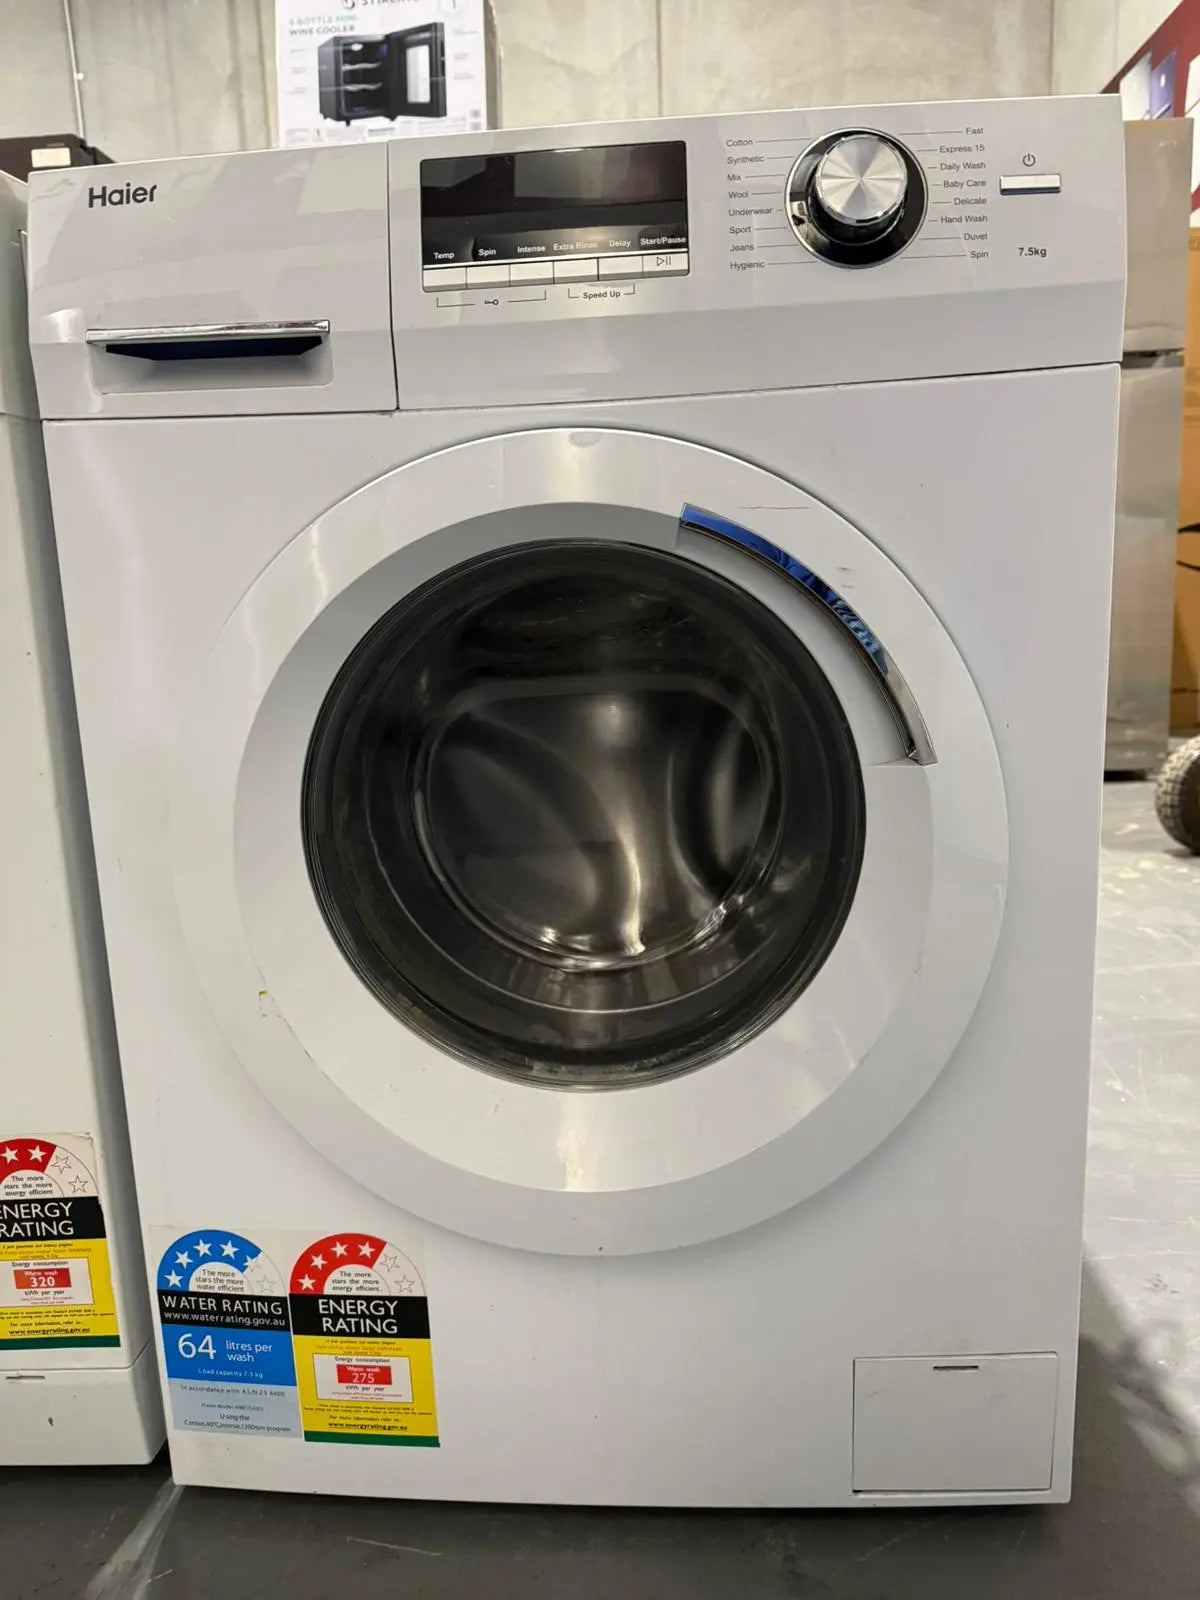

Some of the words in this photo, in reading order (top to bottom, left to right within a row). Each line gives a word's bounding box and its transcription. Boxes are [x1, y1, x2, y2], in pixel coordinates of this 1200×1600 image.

[289, 28, 314, 36] WINE
[316, 25, 355, 35] COOLER
[965, 127, 984, 135] Fast
[726, 139, 753, 147] Cotton
[939, 144, 972, 154] Express
[975, 144, 985, 152] 15
[727, 155, 765, 165] Synthetic
[940, 162, 960, 171] Daily
[962, 161, 986, 169] Wash
[727, 174, 741, 182] Mix
[943, 180, 964, 190] Baby
[966, 178, 987, 187] Care
[88, 182, 158, 208] Haier
[728, 191, 750, 199] Wool
[953, 196, 987, 205] Delicate
[728, 207, 773, 217] Underwear
[940, 214, 963, 223] Hand
[964, 213, 988, 222] Wash
[728, 225, 752, 236] Sport
[640, 236, 686, 246] Start/Pause
[963, 232, 988, 240] Duvet
[553, 243, 575, 251] Extra
[576, 241, 598, 249] Rinse
[609, 239, 632, 248] Delay
[730, 243, 755, 252] Jeans
[478, 248, 497, 257] Spin
[517, 245, 546, 254] Intense
[1018, 246, 1047, 258] 7.5kg
[433, 251, 455, 260] Temp
[970, 250, 989, 260] Spin
[730, 260, 766, 271] Hygienic
[583, 290, 608, 300] Speed
[609, 289, 621, 298] Up
[0, 1201, 72, 1220] NERGY
[202, 1269, 216, 1277] The
[30, 1276, 56, 1288] 320
[213, 1277, 225, 1285] the
[218, 1285, 245, 1293] efficient
[163, 1295, 217, 1312] WATER
[222, 1299, 283, 1315] RATING
[318, 1299, 398, 1315] ENERGY
[164, 1311, 286, 1327] www.waterrating.gov.au
[322, 1317, 397, 1334] RATING
[178, 1333, 217, 1361] 64
[226, 1341, 252, 1351] litres
[255, 1343, 273, 1354] per
[227, 1353, 254, 1362] wash
[351, 1373, 376, 1384] 275
